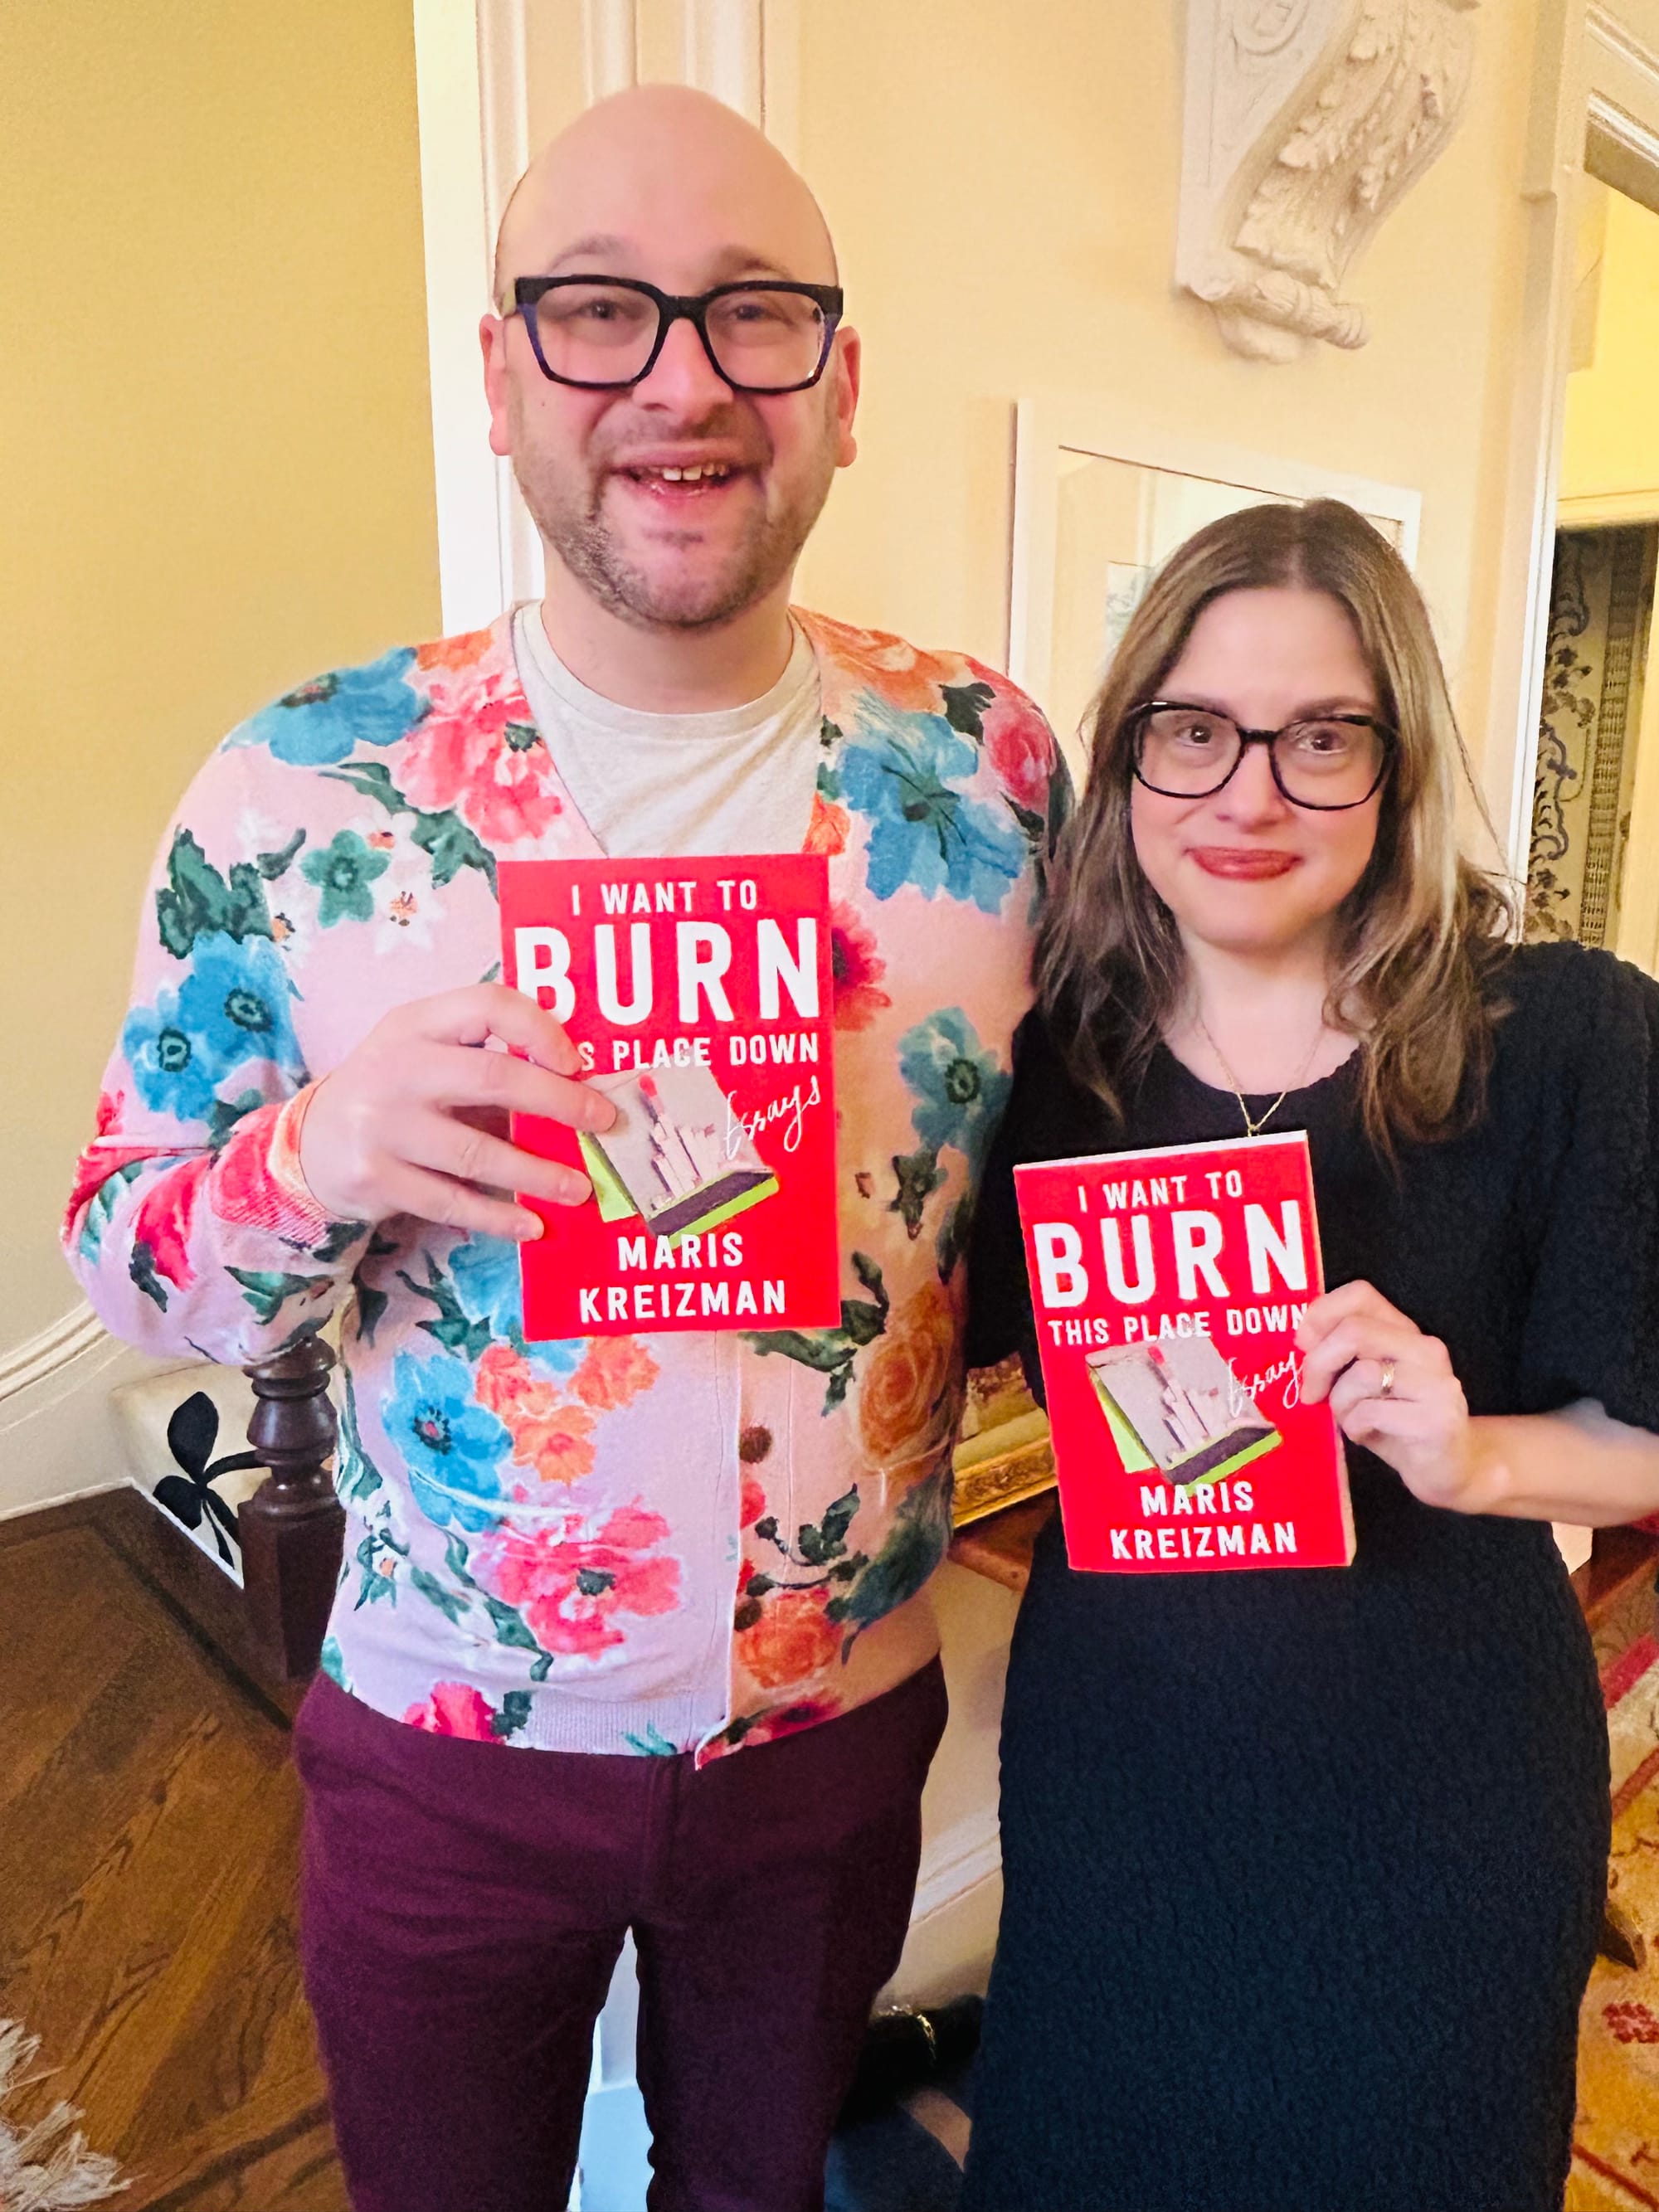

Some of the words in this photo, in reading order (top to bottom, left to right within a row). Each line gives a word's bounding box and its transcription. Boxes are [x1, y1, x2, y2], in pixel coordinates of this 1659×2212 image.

[572, 885, 580, 915] I
[601, 882, 697, 914] WANT
[717, 880, 757, 911] TO
[514, 917, 820, 1026] BURN
[612, 1038, 712, 1071] PLACE
[729, 1033, 819, 1066] DOWN
[722, 1074, 821, 1160] Essays
[1079, 1186, 1087, 1213] I
[1102, 1175, 1187, 1210] WANT
[1204, 1169, 1243, 1199] TO
[617, 1232, 744, 1271] MARIS
[1033, 1199, 1307, 1309] BURN
[579, 1280, 786, 1324] KREIZMAN
[1048, 1319, 1109, 1347] THIS
[1125, 1311, 1211, 1343] PLACE
[1227, 1303, 1308, 1336] DOWN
[1227, 1350, 1302, 1418] Essay
[1140, 1480, 1254, 1518] MARIS
[1110, 1522, 1298, 1560] KREIZMAN
